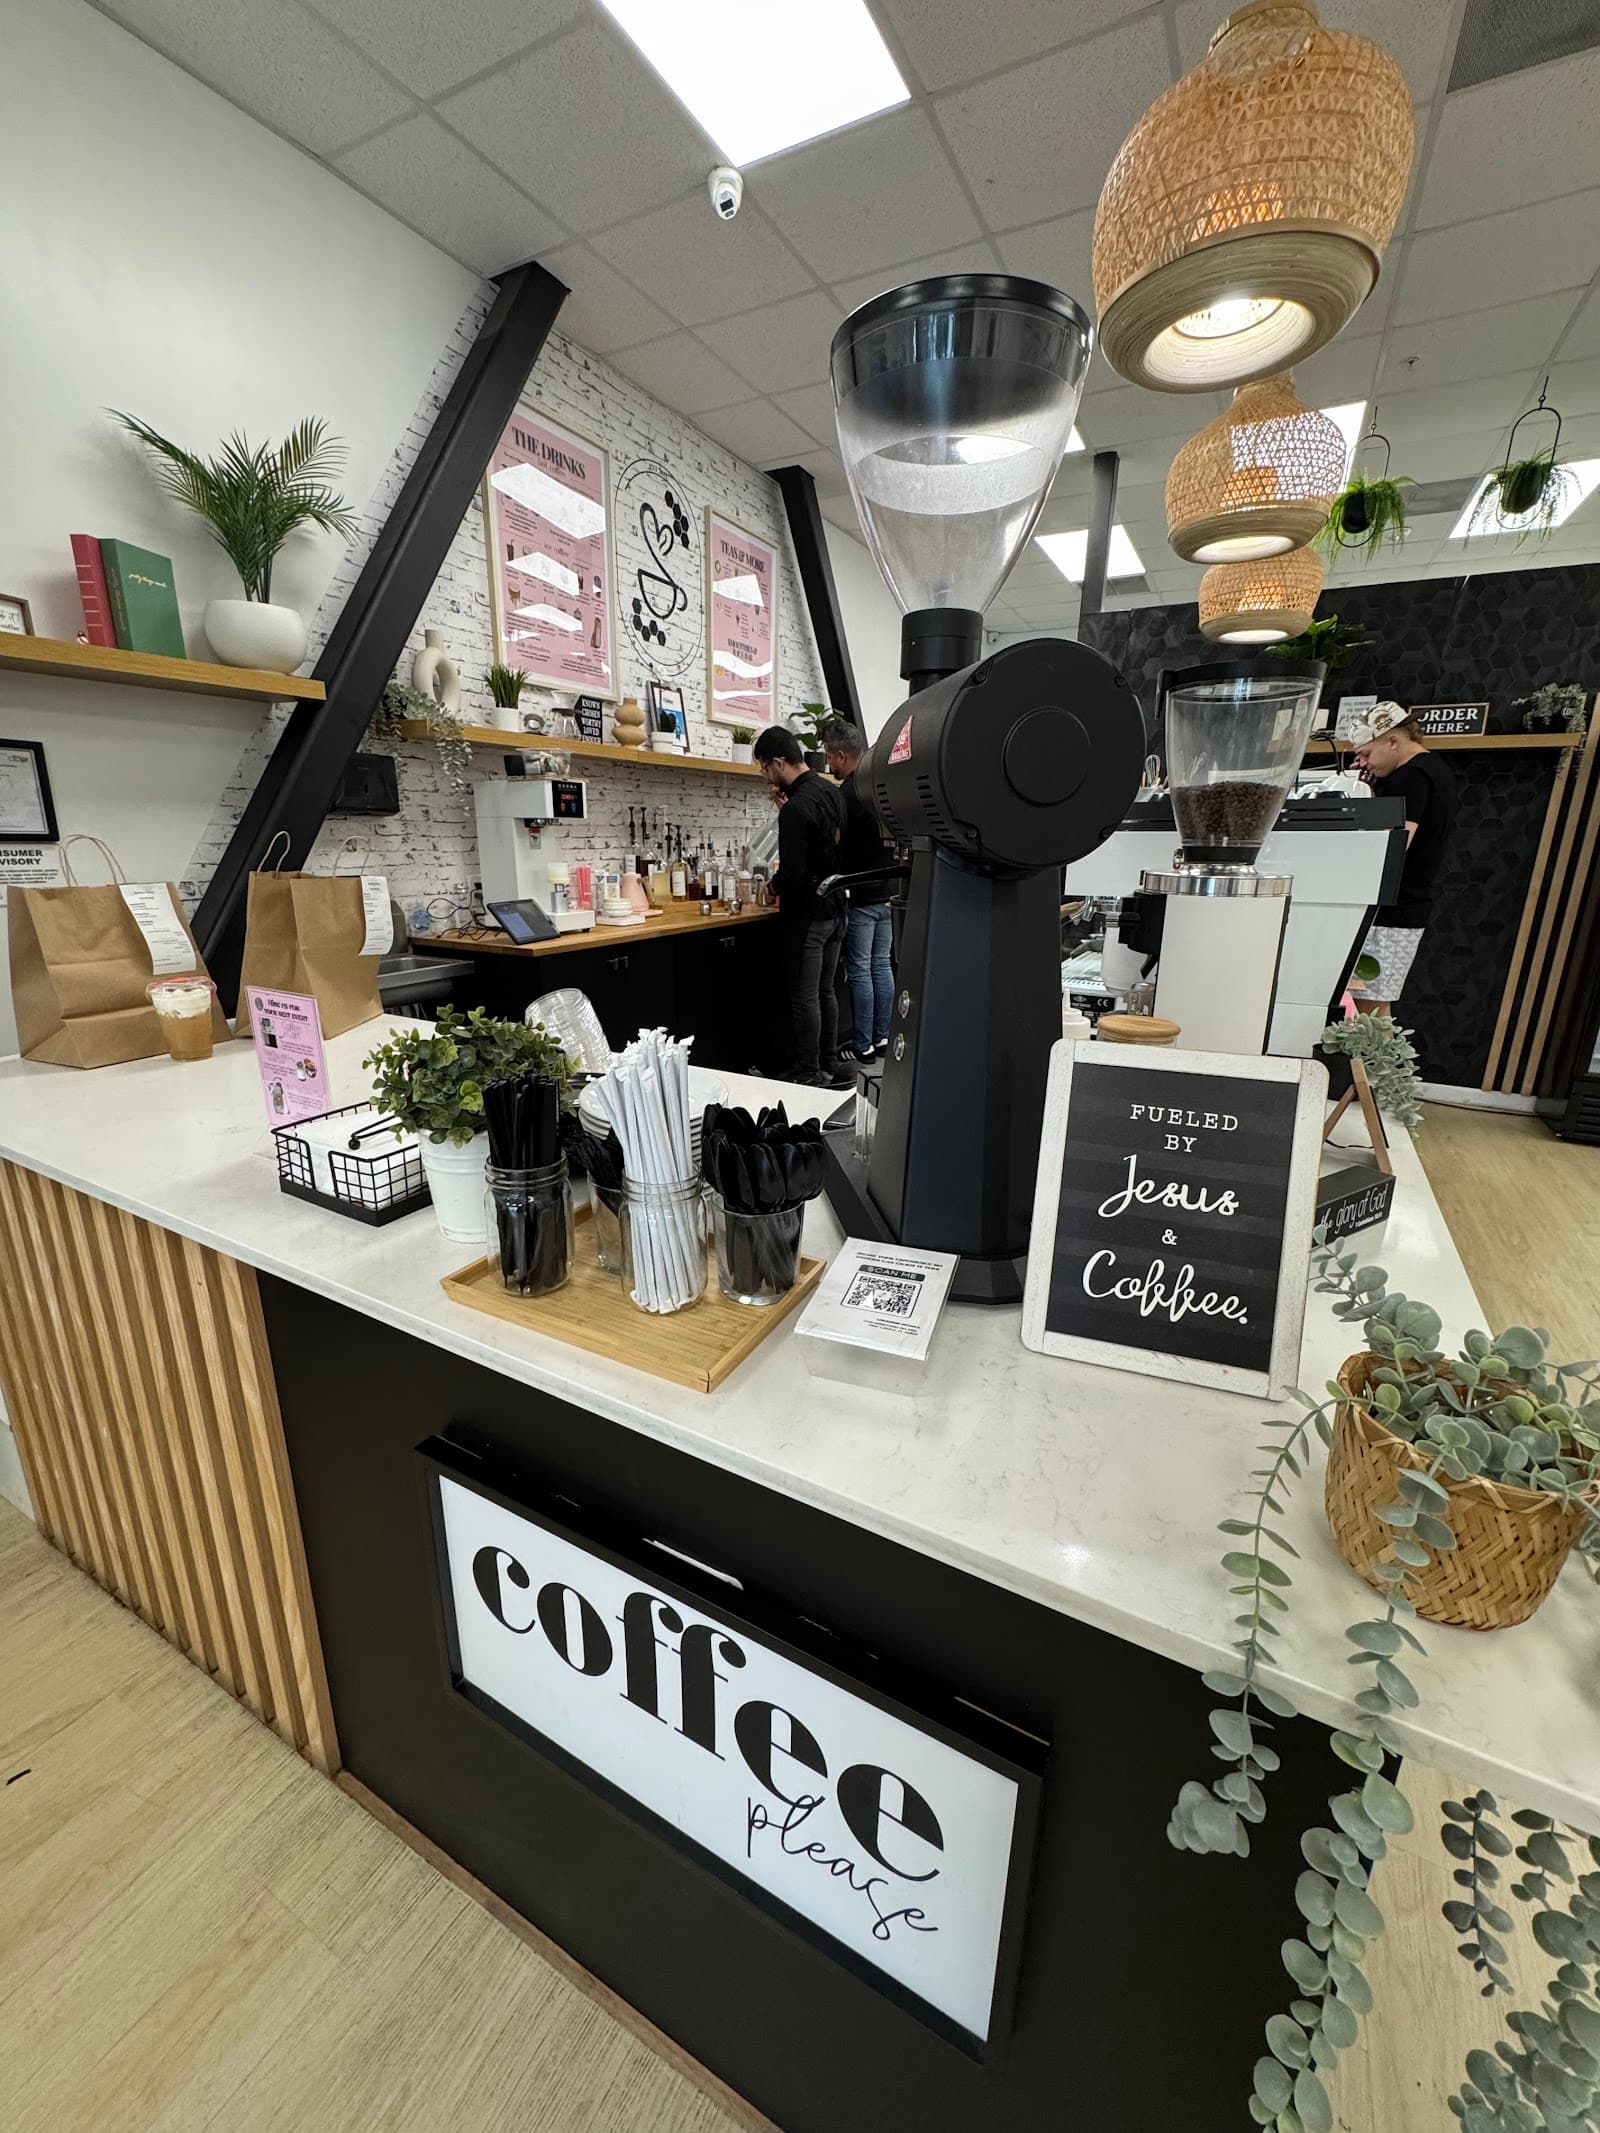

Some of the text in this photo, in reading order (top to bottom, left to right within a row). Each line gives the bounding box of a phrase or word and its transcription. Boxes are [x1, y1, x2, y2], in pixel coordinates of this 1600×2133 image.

[512, 427, 586, 479] THE DRINKS
[720, 540, 738, 560] TEAS
[746, 554, 766, 574] MORE
[583, 726, 600, 737] LOVED
[1130, 1104, 1239, 1131] FUELED
[1164, 1134, 1197, 1153] BY
[1098, 1154, 1239, 1218] Jesus
[1320, 1183, 1388, 1234] the glory of God
[1161, 1229, 1177, 1246] &
[867, 1266, 917, 1280] SCAN ME
[1082, 1250, 1248, 1325] Coffee.
[472, 1546, 944, 1881] coffee
[747, 1794, 938, 1940] please
